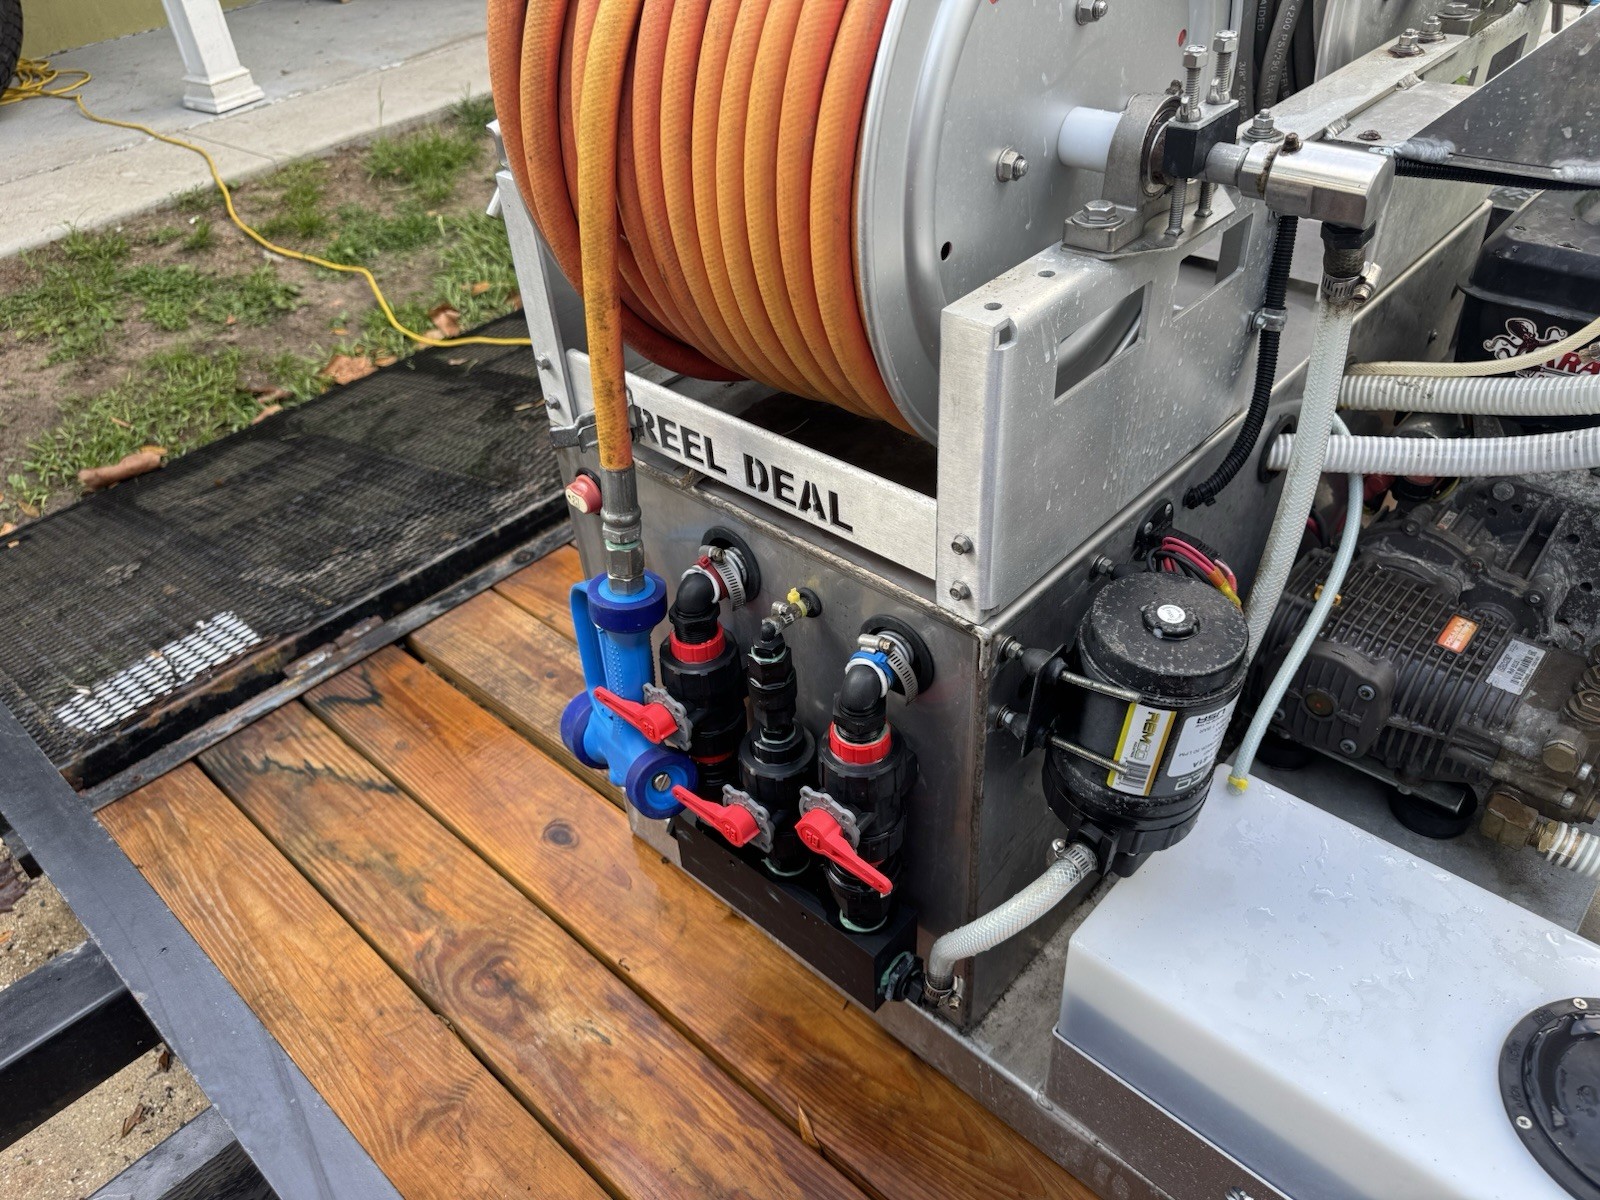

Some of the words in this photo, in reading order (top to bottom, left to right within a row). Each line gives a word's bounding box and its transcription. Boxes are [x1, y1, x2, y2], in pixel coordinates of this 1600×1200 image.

[1282, 5, 1296, 30] 4200
[637, 407, 728, 477] REEL
[742, 452, 854, 534] DEAL
[1196, 707, 1227, 724] USA
[1133, 711, 1160, 761] REMCO
